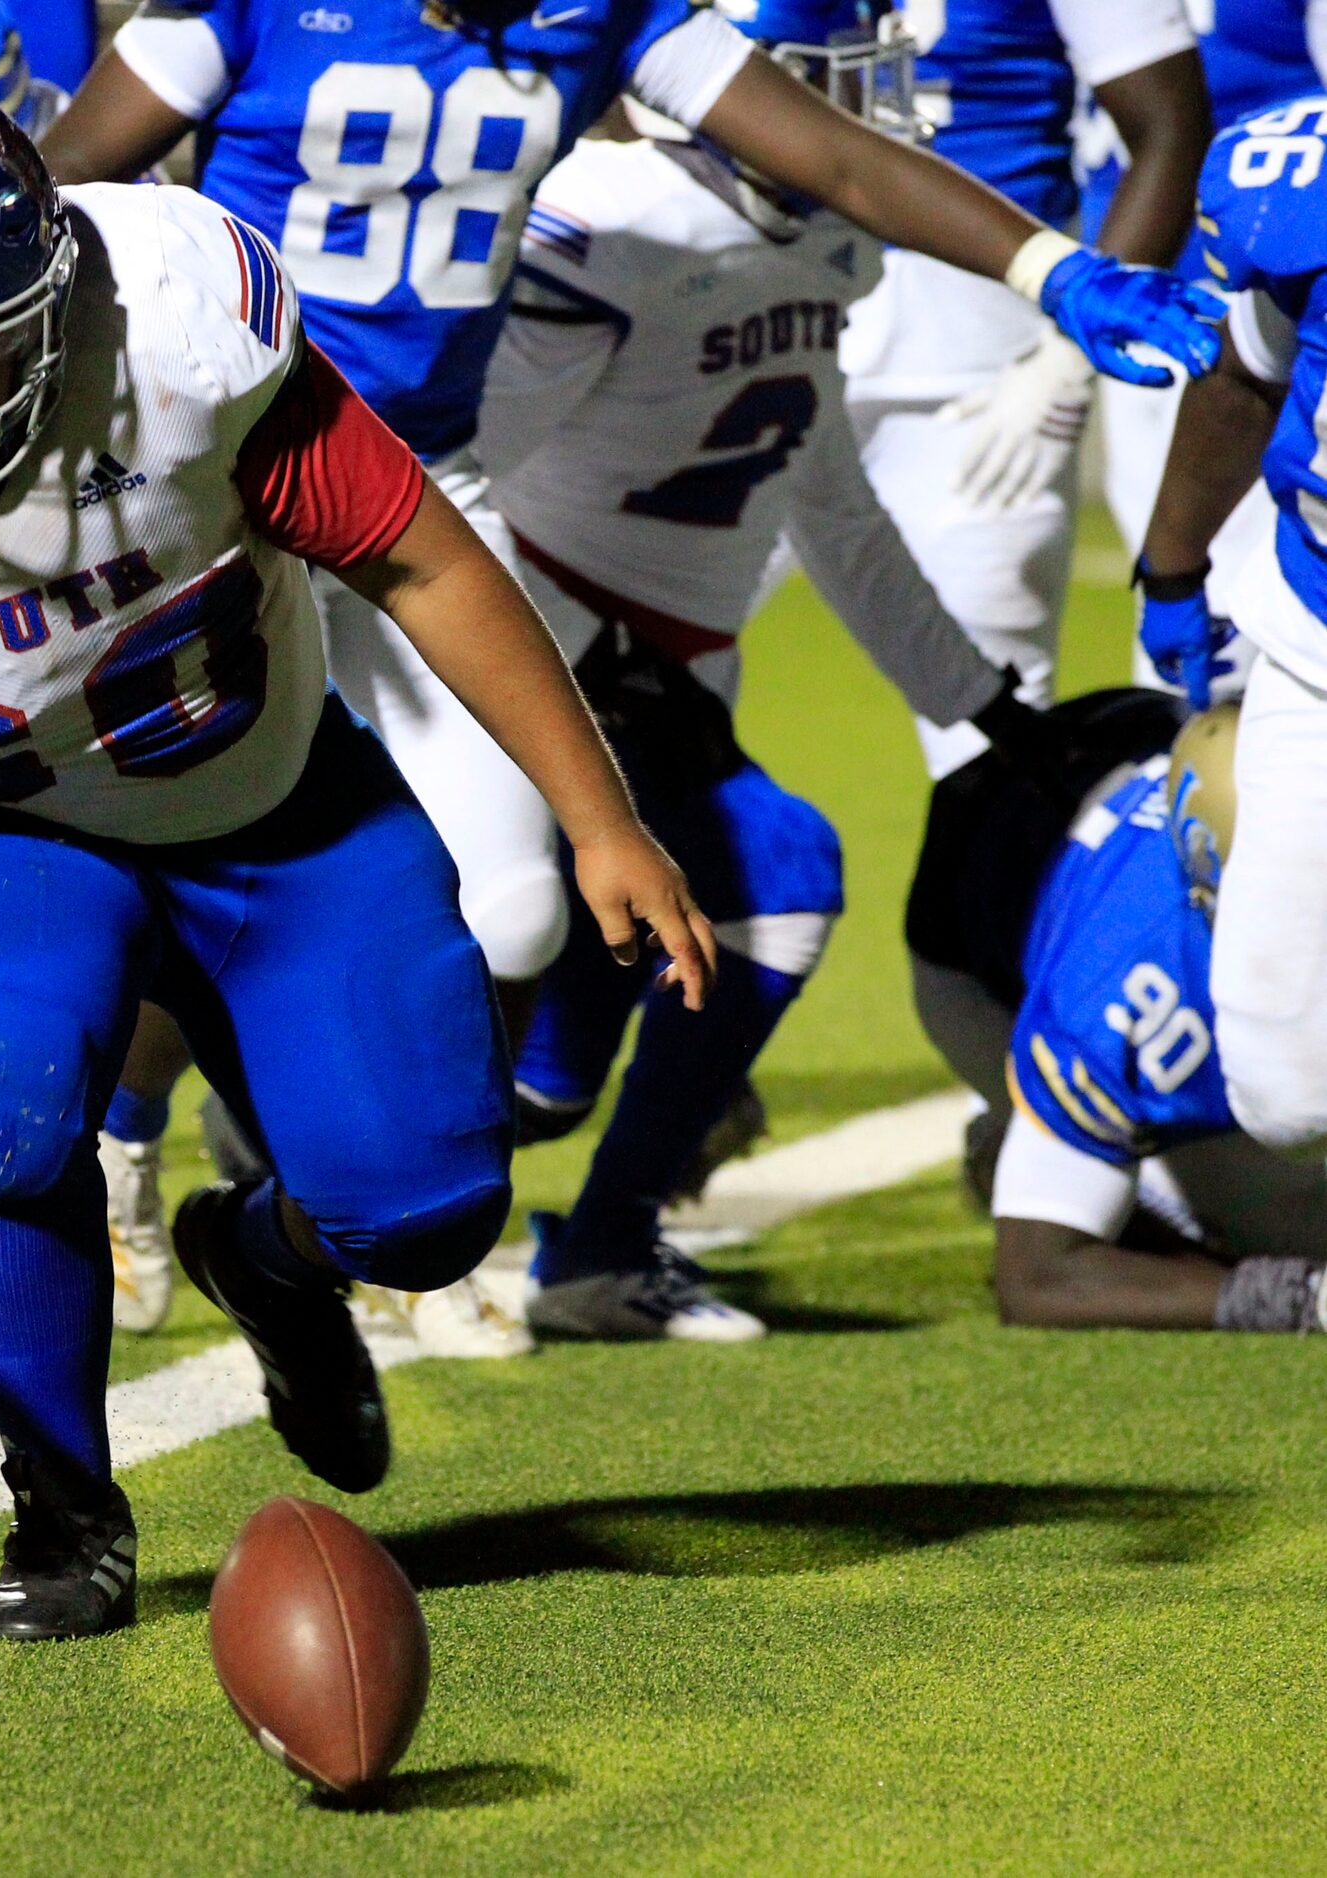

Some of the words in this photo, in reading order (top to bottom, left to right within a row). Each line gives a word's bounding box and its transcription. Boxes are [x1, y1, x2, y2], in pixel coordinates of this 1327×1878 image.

[280, 60, 562, 308] 88
[73, 472, 148, 510] adidas
[621, 374, 817, 528] 2
[1104, 962, 1211, 1094] 90
